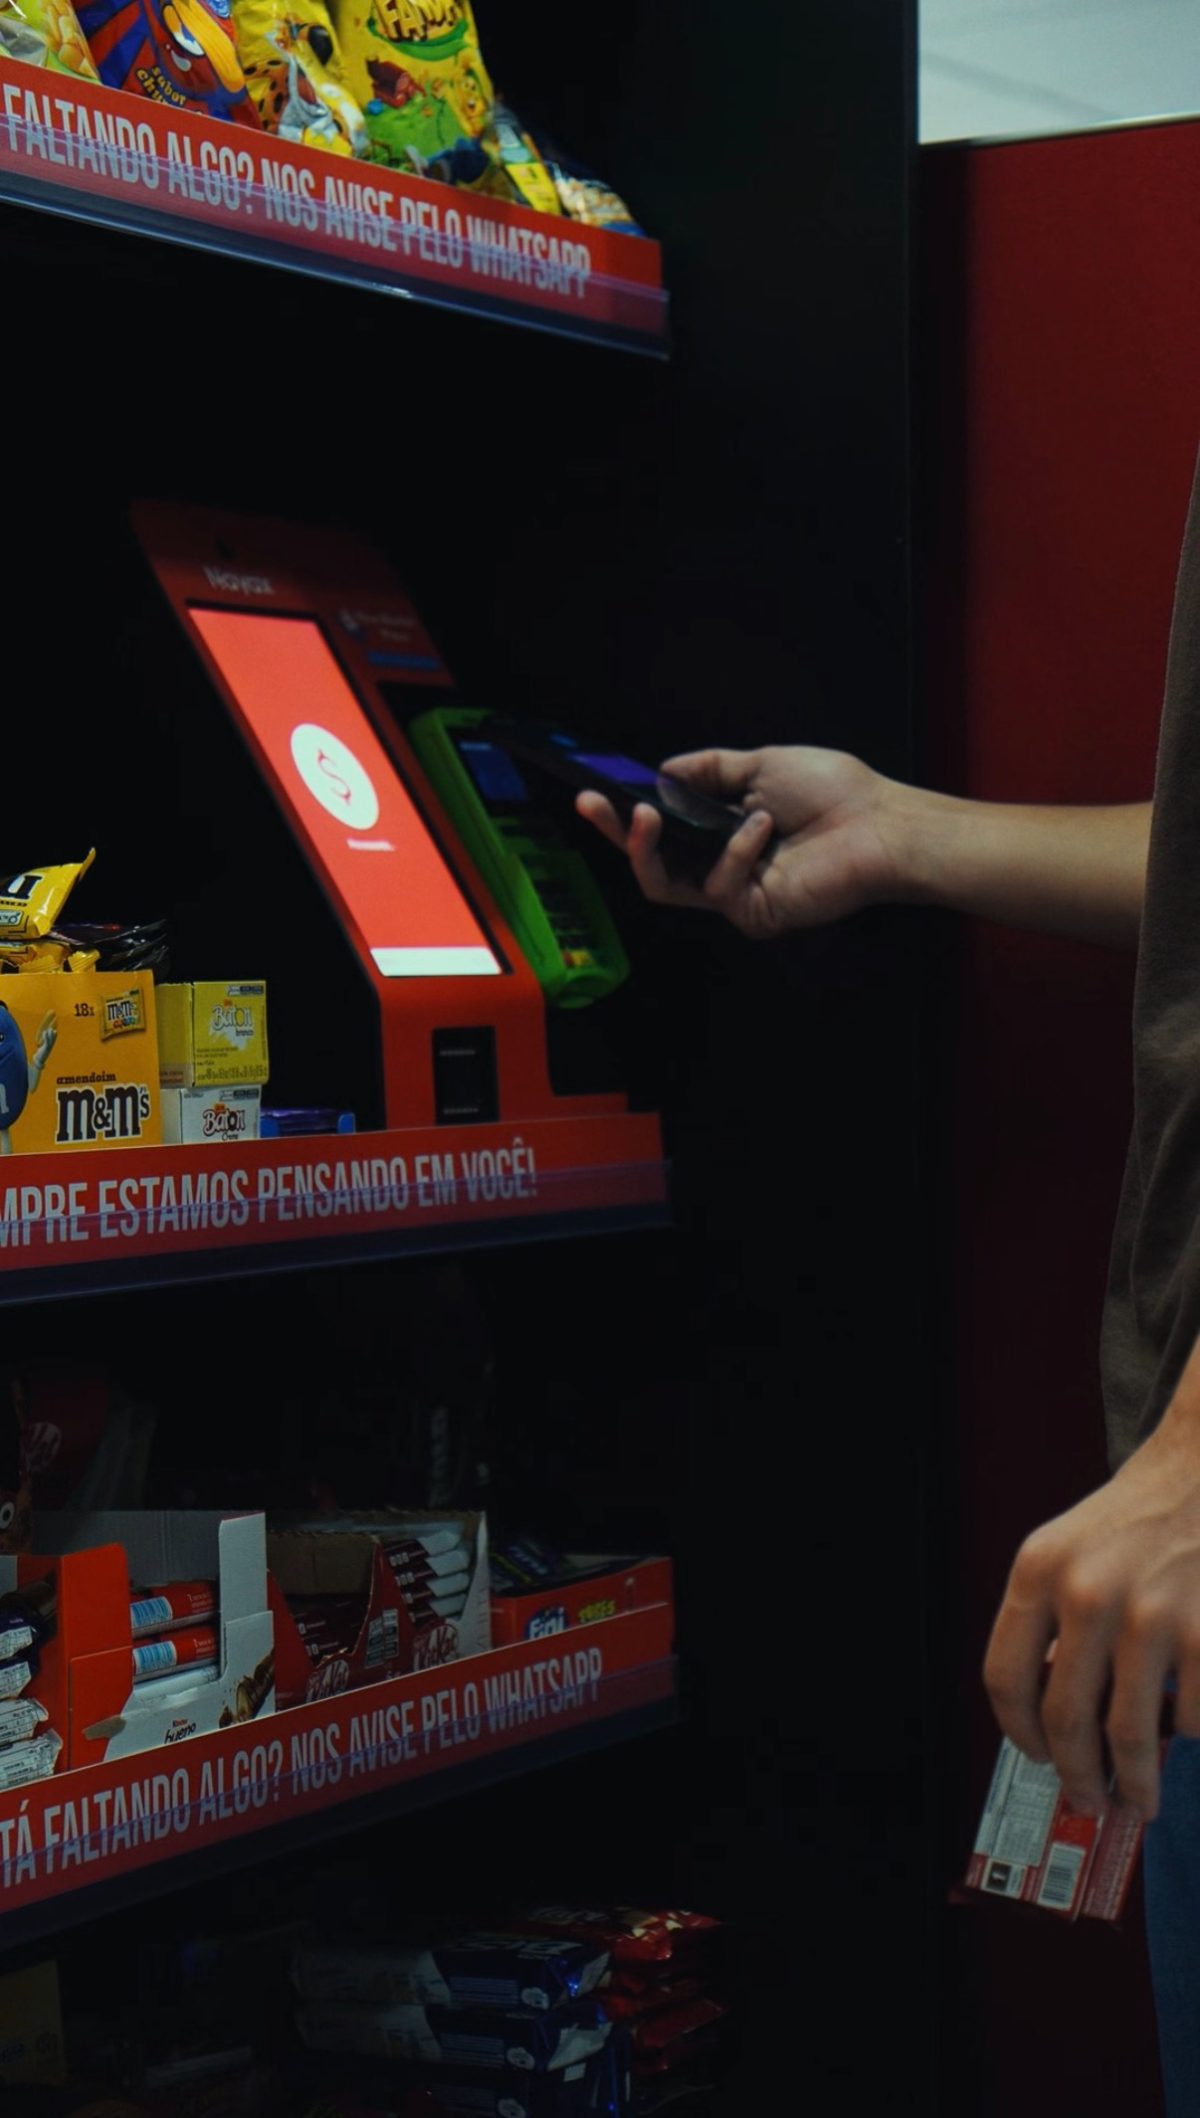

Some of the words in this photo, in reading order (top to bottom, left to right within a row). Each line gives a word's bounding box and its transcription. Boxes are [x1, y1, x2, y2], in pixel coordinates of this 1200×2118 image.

[151, 66, 187, 107] sabor
[3, 83, 160, 190] FALTANDO
[167, 131, 254, 215] ALGO?
[260, 157, 319, 230] NOS
[324, 175, 398, 252] AVISE
[400, 196, 463, 269] PELO
[466, 214, 592, 299] WHATSAPP
[56, 1070, 117, 1085] amendoim
[99, 1168, 250, 1239] ESTAMOS
[258, 1157, 409, 1223] PENSANDO
[414, 1152, 458, 1209] EM
[461, 1136, 539, 1203] VOCÊ!
[43, 1767, 192, 1875] FALTANDO
[199, 1739, 284, 1826] ALGO?
[291, 1722, 342, 1796] NOS
[349, 1700, 418, 1778] AVISE
[420, 1681, 481, 1755] PELO
[483, 1647, 603, 1735] WHATSAPP
